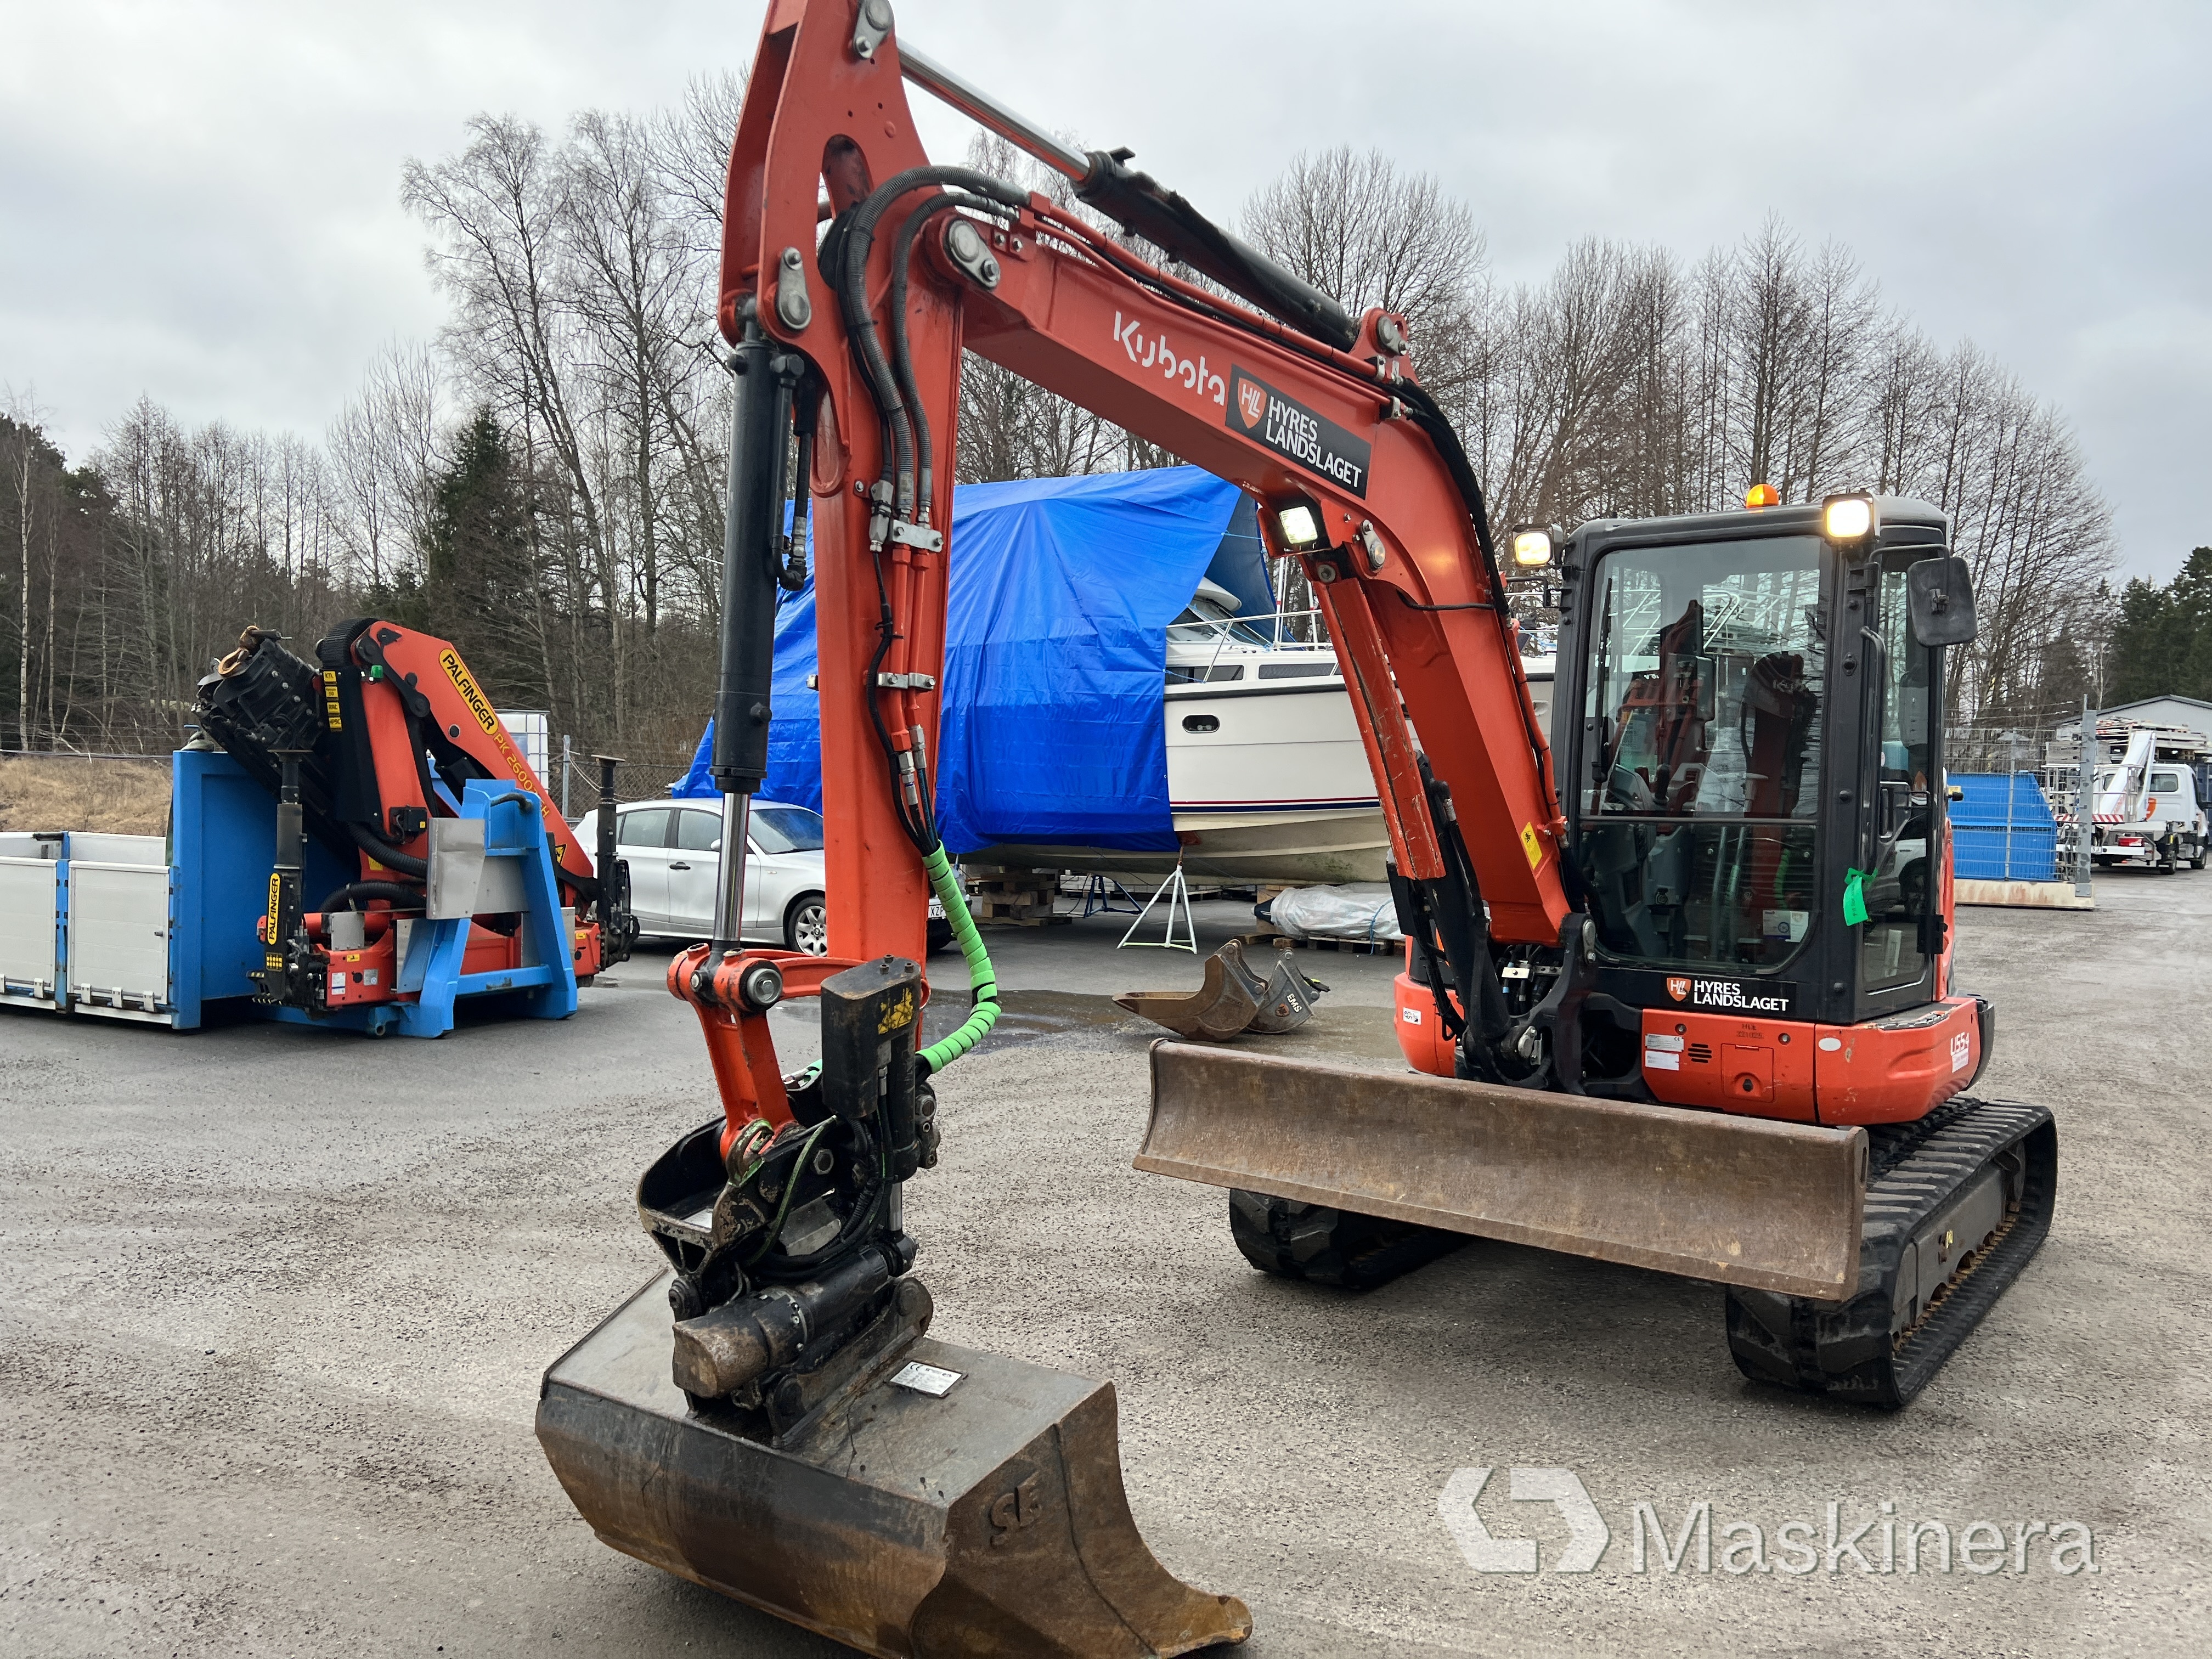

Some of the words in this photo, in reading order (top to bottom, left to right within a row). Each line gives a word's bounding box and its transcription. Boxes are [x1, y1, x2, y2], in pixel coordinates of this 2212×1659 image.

[1114, 311, 1225, 406] Kubota
[1269, 396, 1318, 442] HYRES
[1266, 418, 1362, 488] LANDSLAGET
[443, 653, 495, 730] PALFINGER
[494, 733, 510, 755] PK
[269, 878, 278, 940] PALFINGER
[1287, 994, 1302, 1013] EMS
[1694, 980, 1741, 995] HYRES
[1694, 992, 1789, 1011] LANDSLAGET
